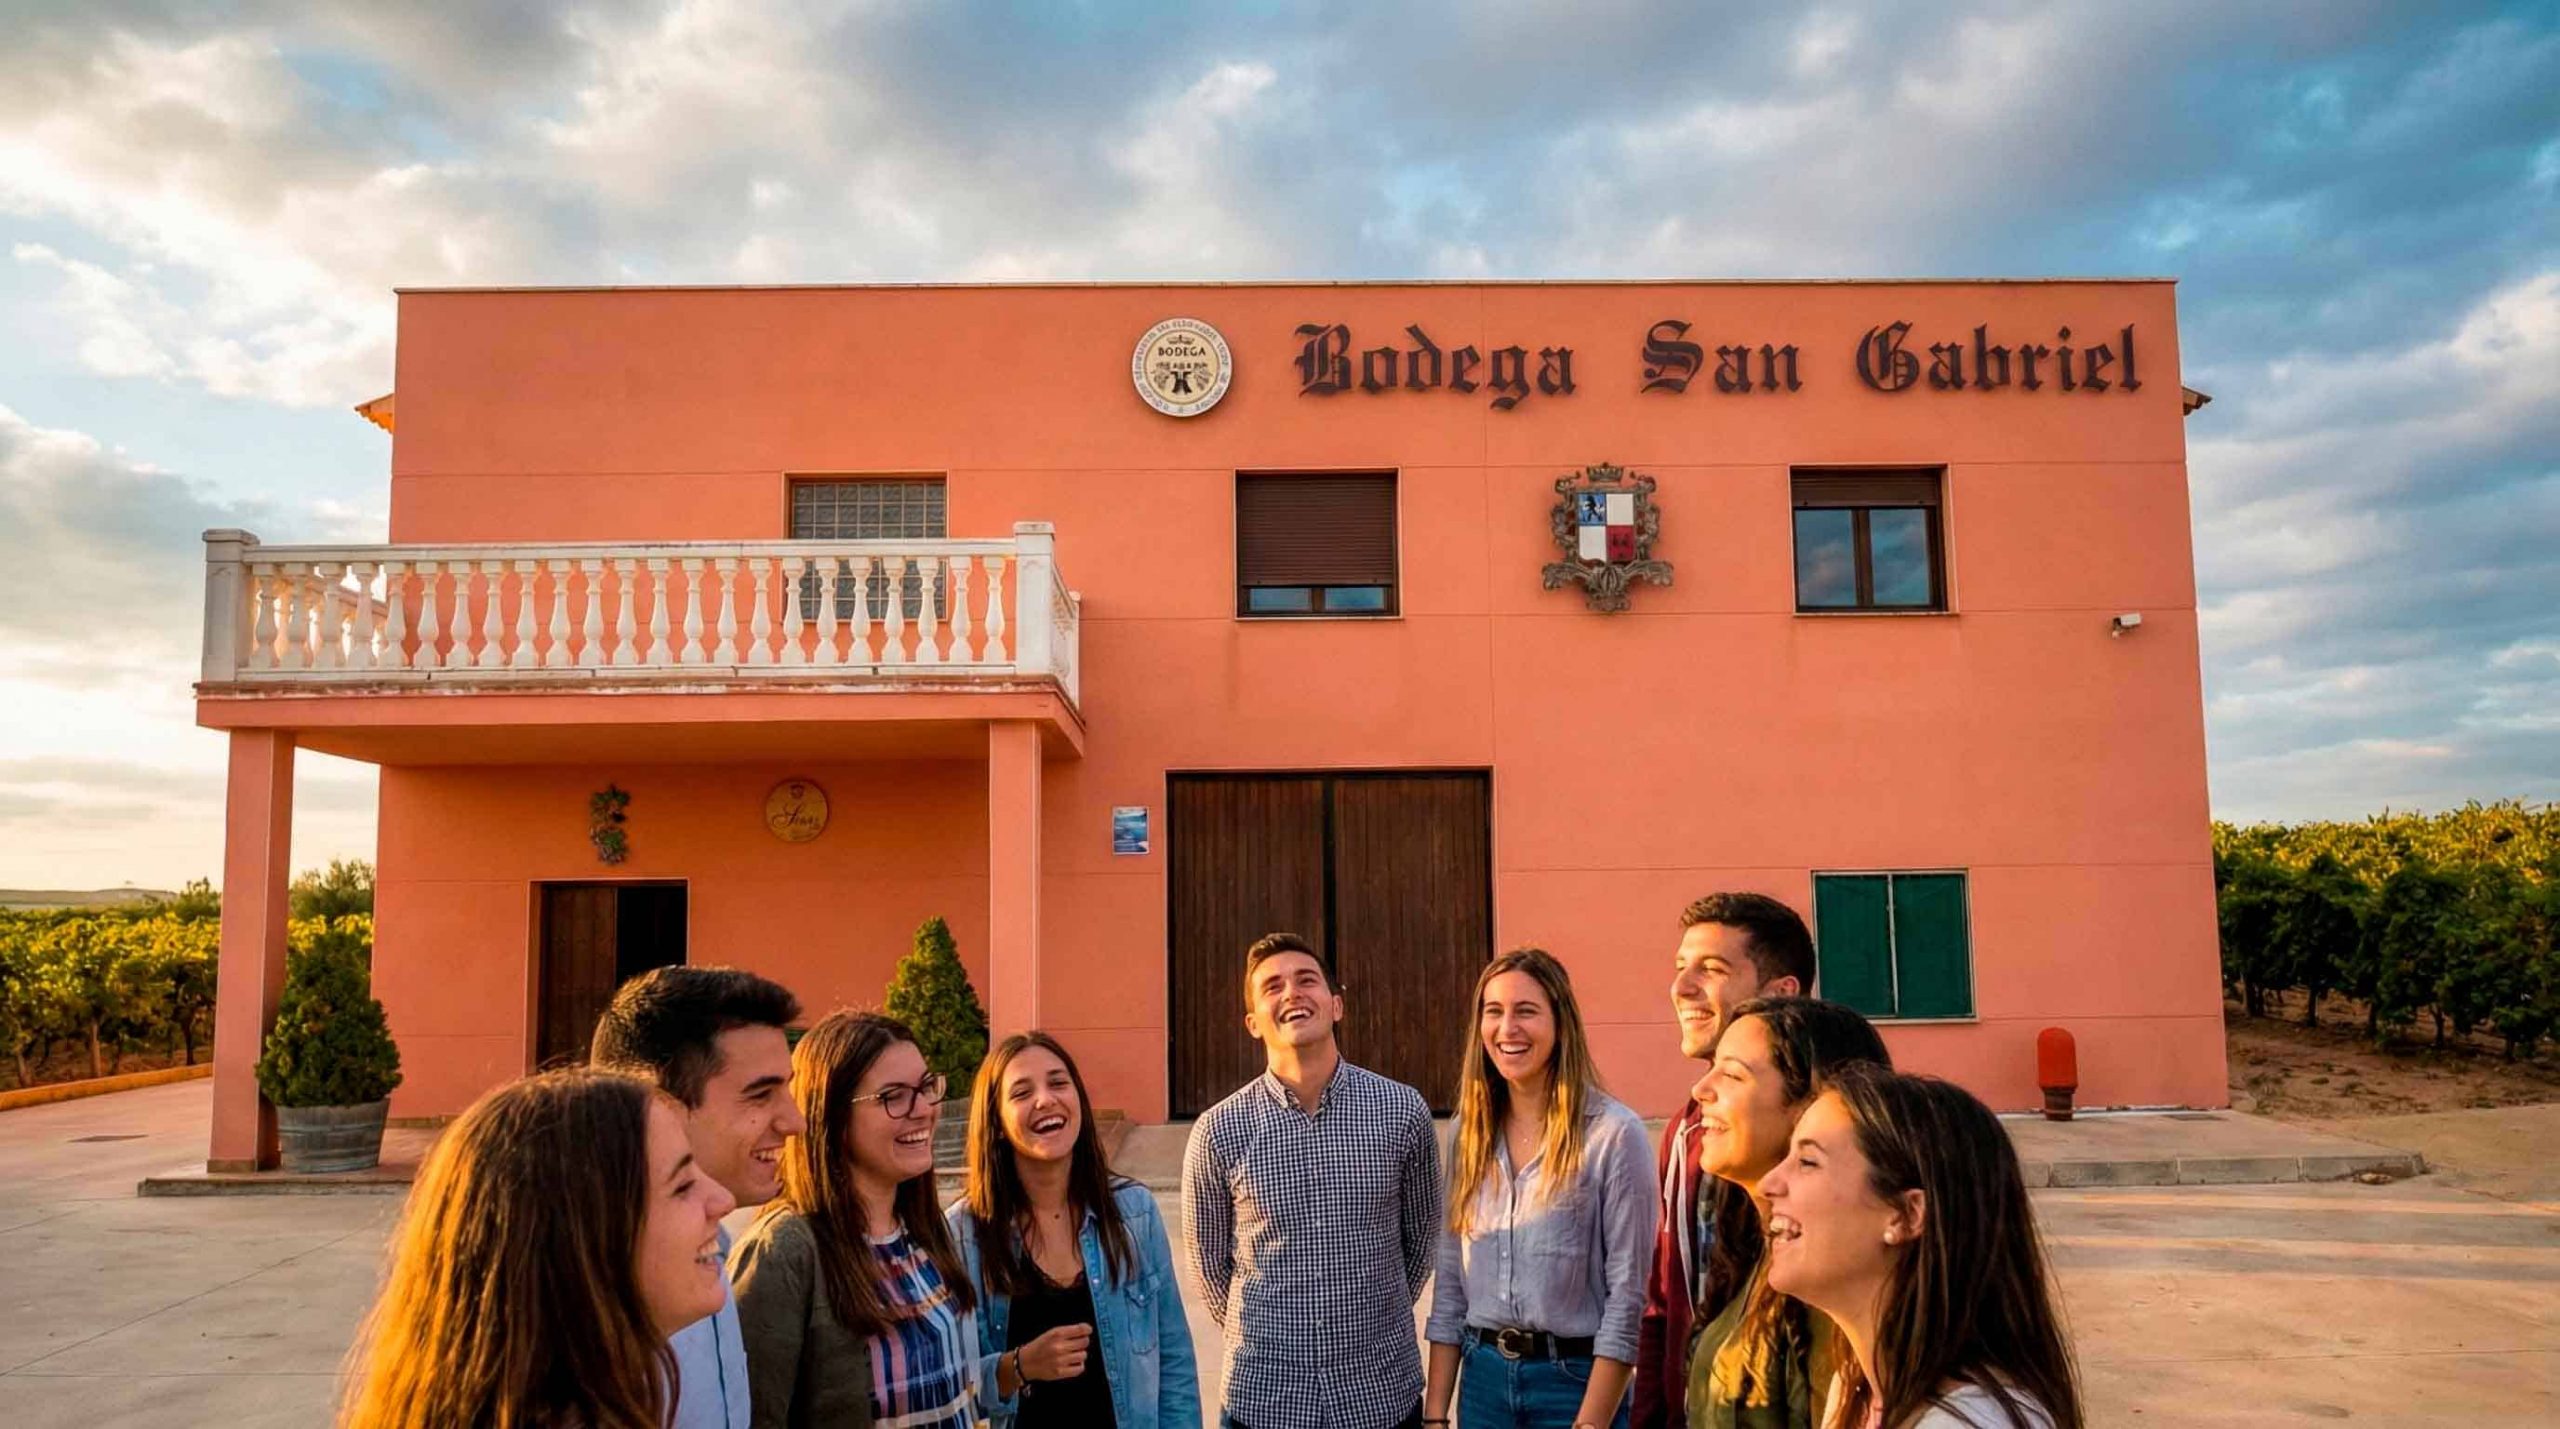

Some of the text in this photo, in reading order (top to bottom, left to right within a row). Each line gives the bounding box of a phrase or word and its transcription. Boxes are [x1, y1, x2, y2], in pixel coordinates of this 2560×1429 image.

[1157, 346, 1206, 357] BODEGA
[1295, 322, 1577, 411] Bodega
[1641, 319, 1803, 394] San
[1856, 320, 2142, 393] Gabriel
